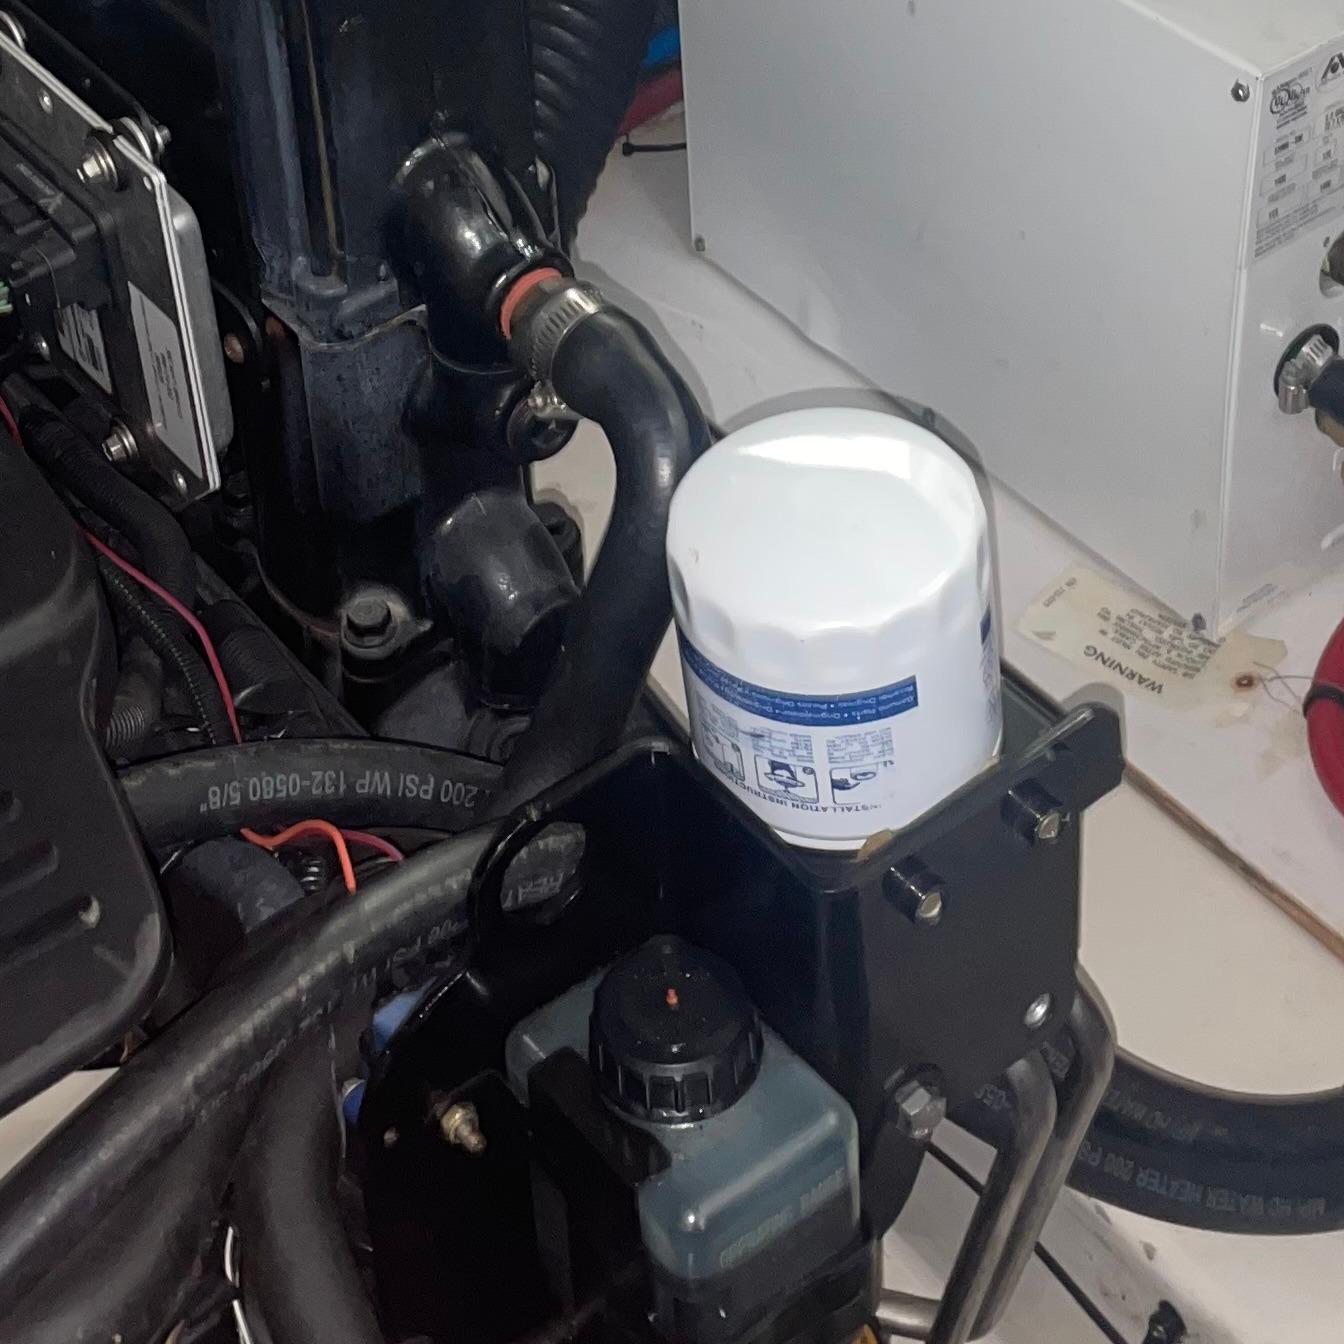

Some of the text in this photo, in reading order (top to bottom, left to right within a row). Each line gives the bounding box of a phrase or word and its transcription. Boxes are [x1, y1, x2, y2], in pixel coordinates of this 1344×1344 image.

[1083, 644, 1165, 694] WARNING
[355, 769, 391, 797] WP
[397, 772, 434, 800] PSI
[440, 780, 476, 807] 200
